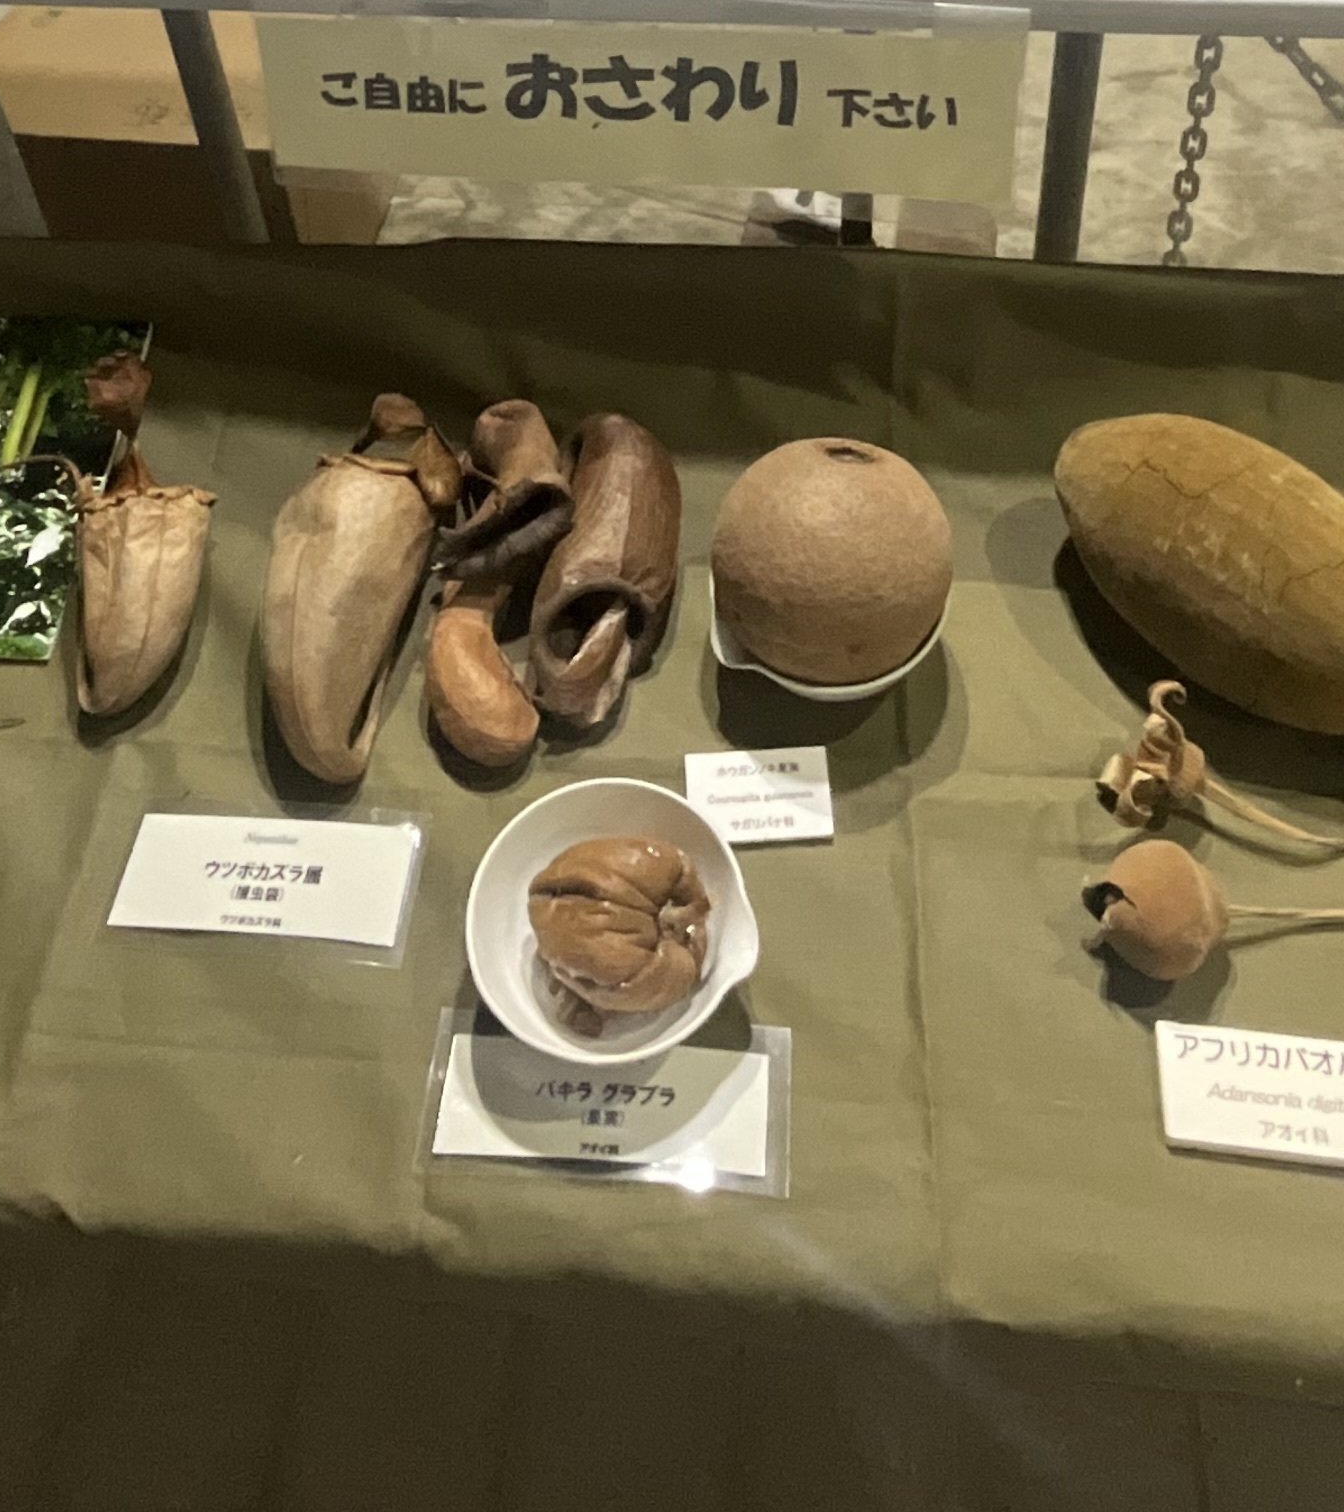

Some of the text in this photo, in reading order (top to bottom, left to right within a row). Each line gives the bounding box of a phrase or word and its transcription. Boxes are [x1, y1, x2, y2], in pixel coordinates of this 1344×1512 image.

[505, 54, 798, 127] おさわり
[827, 89, 958, 130] 下さい
[1206, 1082, 1303, 1110] Adansonia
